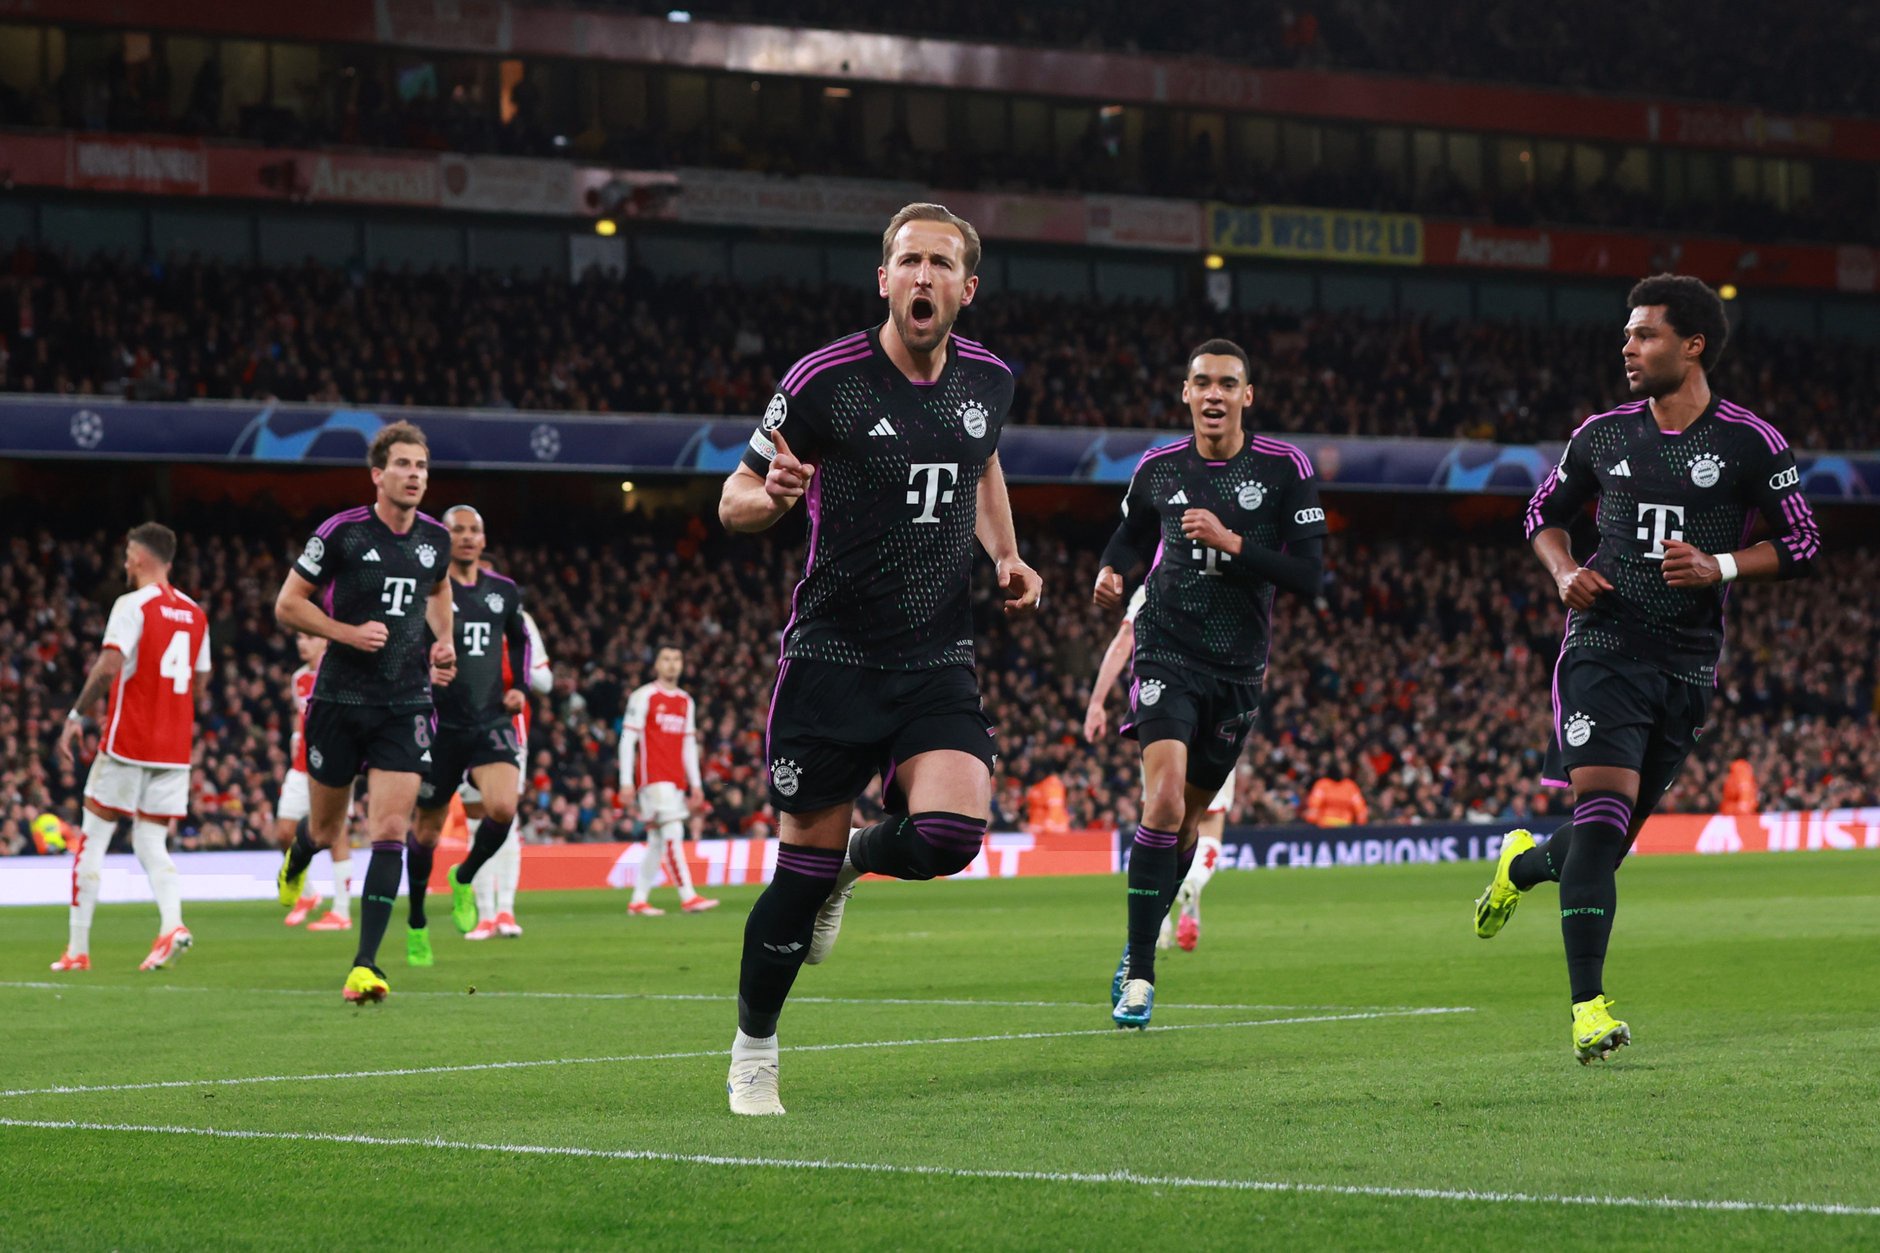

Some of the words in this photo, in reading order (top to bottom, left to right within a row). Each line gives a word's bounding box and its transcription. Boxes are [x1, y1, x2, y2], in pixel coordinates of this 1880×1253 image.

[312, 157, 434, 199] Arsenal
[1457, 228, 1549, 264] Arsenal
[906, 463, 958, 523] T
[1637, 502, 1685, 559] T
[381, 576, 417, 616] T
[463, 622, 491, 656] T
[160, 630, 192, 694] 4
[414, 715, 431, 748] 8
[1266, 836, 1459, 870] CHAMPIONS
